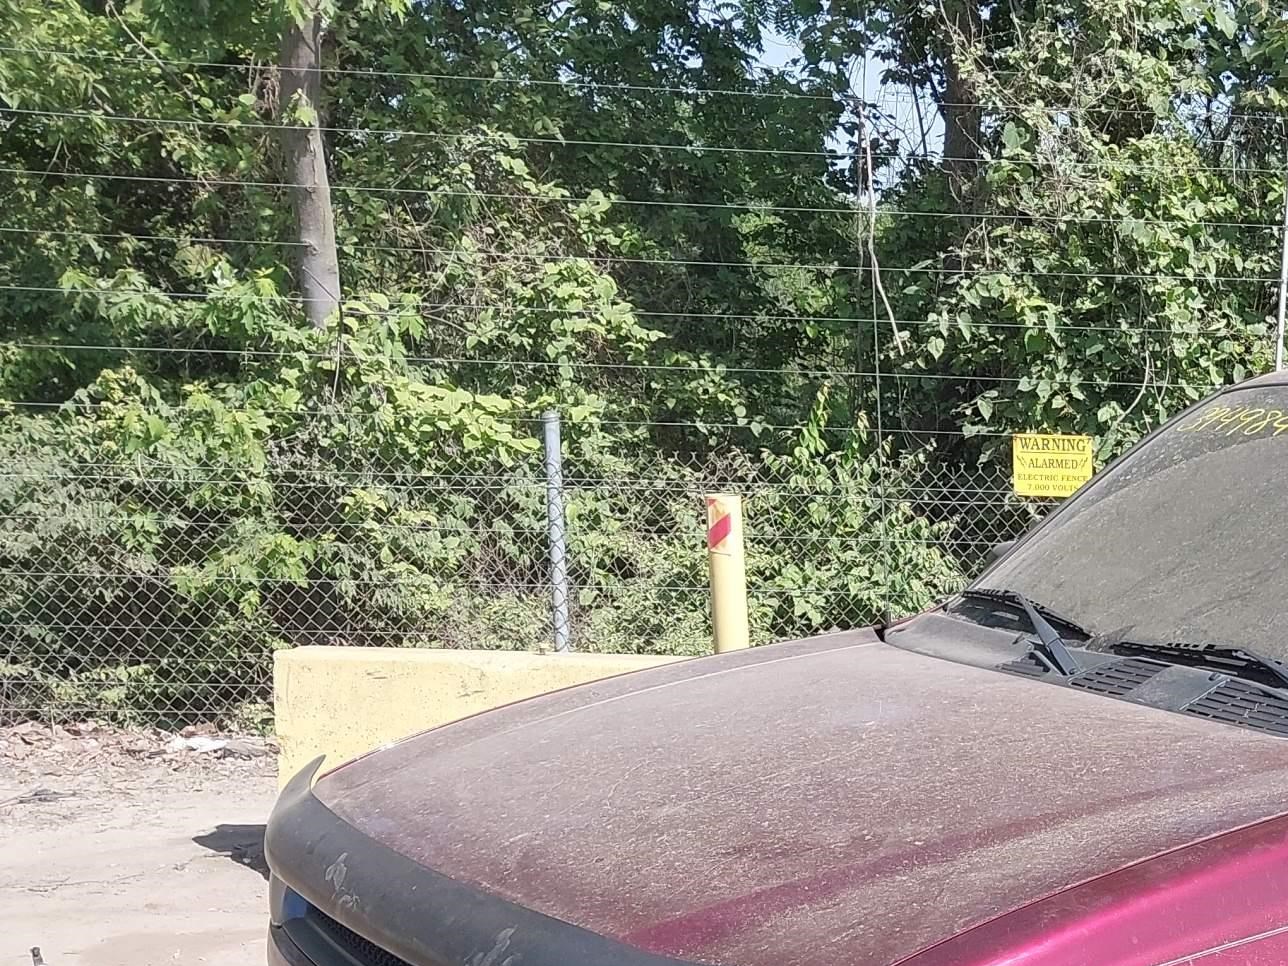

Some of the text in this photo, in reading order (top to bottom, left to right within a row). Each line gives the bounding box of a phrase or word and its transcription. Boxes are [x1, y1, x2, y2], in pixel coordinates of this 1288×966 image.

[1020, 438, 1086, 451] WARNING
[1028, 458, 1078, 469] ALARMED
[1018, 473, 1059, 481] ELECTRIC
